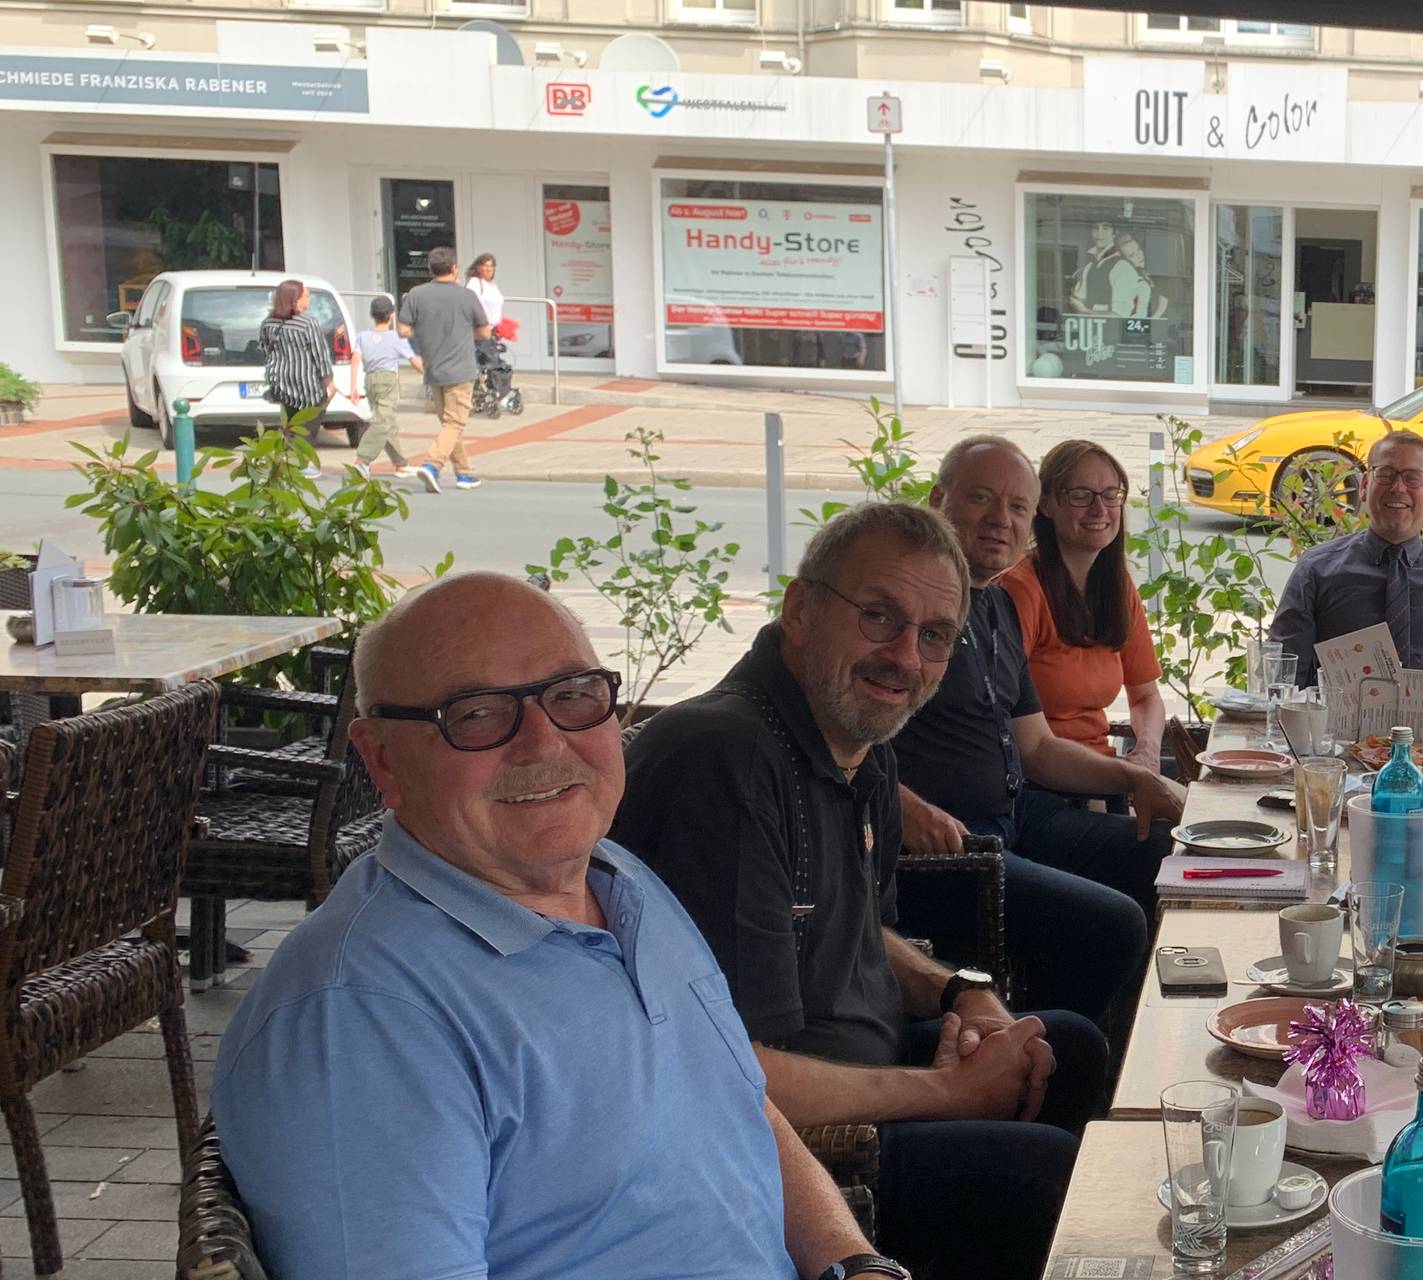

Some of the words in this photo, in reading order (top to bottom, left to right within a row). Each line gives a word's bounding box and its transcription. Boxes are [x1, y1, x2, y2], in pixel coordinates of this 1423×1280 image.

[0, 71, 74, 87] CHMIEDE
[80, 73, 179, 90] FRANZISKA
[185, 78, 267, 94] RABENER
[552, 89, 586, 110] DB
[1135, 89, 1189, 147] CUT
[1207, 115, 1225, 148] &
[1245, 93, 1318, 150] Color
[686, 228, 860, 256] Handy-Store
[1065, 317, 1107, 351] CUT
[1126, 320, 1150, 332] 24,-
